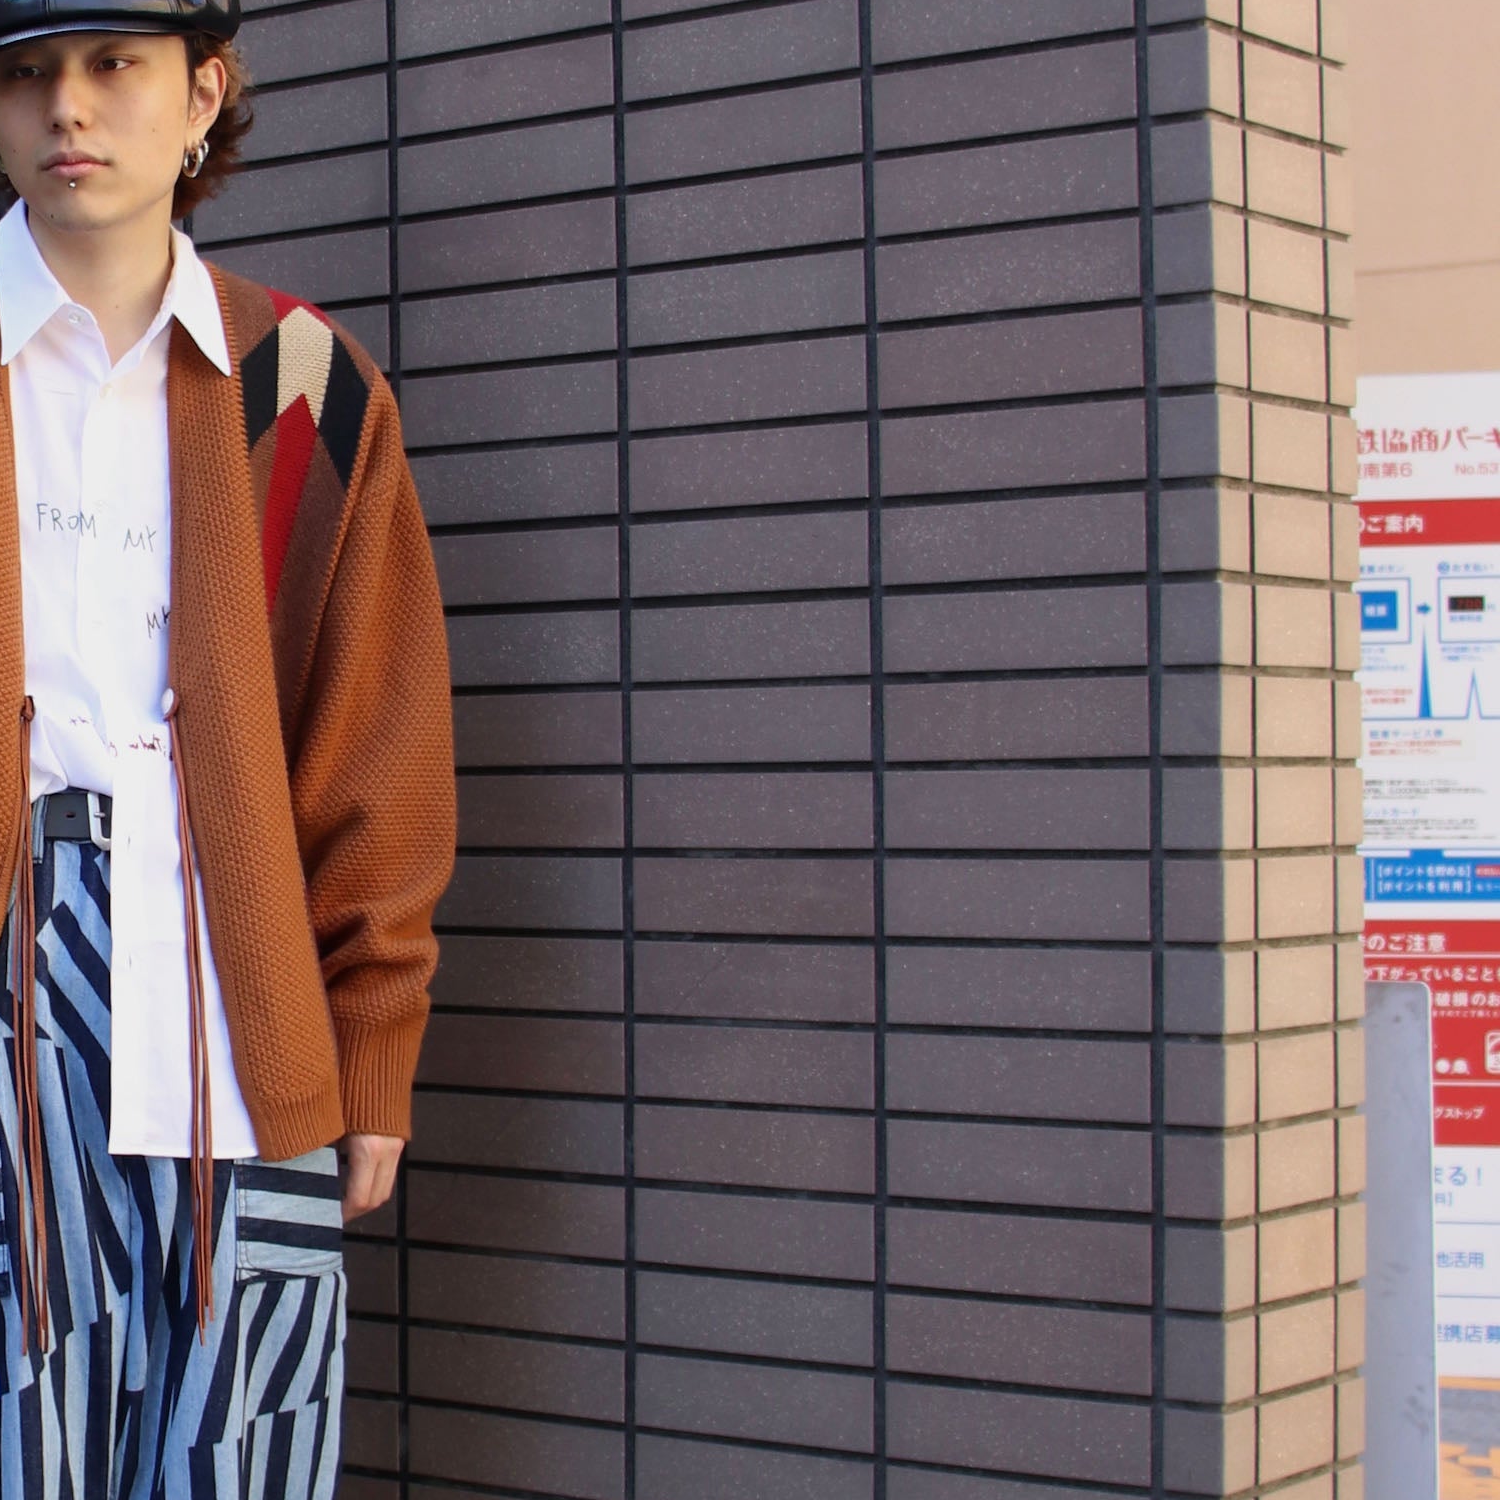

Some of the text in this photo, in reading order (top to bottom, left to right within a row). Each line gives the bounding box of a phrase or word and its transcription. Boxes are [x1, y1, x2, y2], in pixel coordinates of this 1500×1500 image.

[1358, 462, 1413, 479] 南第6
[36, 503, 97, 539] FROM
[1364, 966, 1500, 982] 下がっていること
[1431, 991, 1500, 1008] 破損のお
